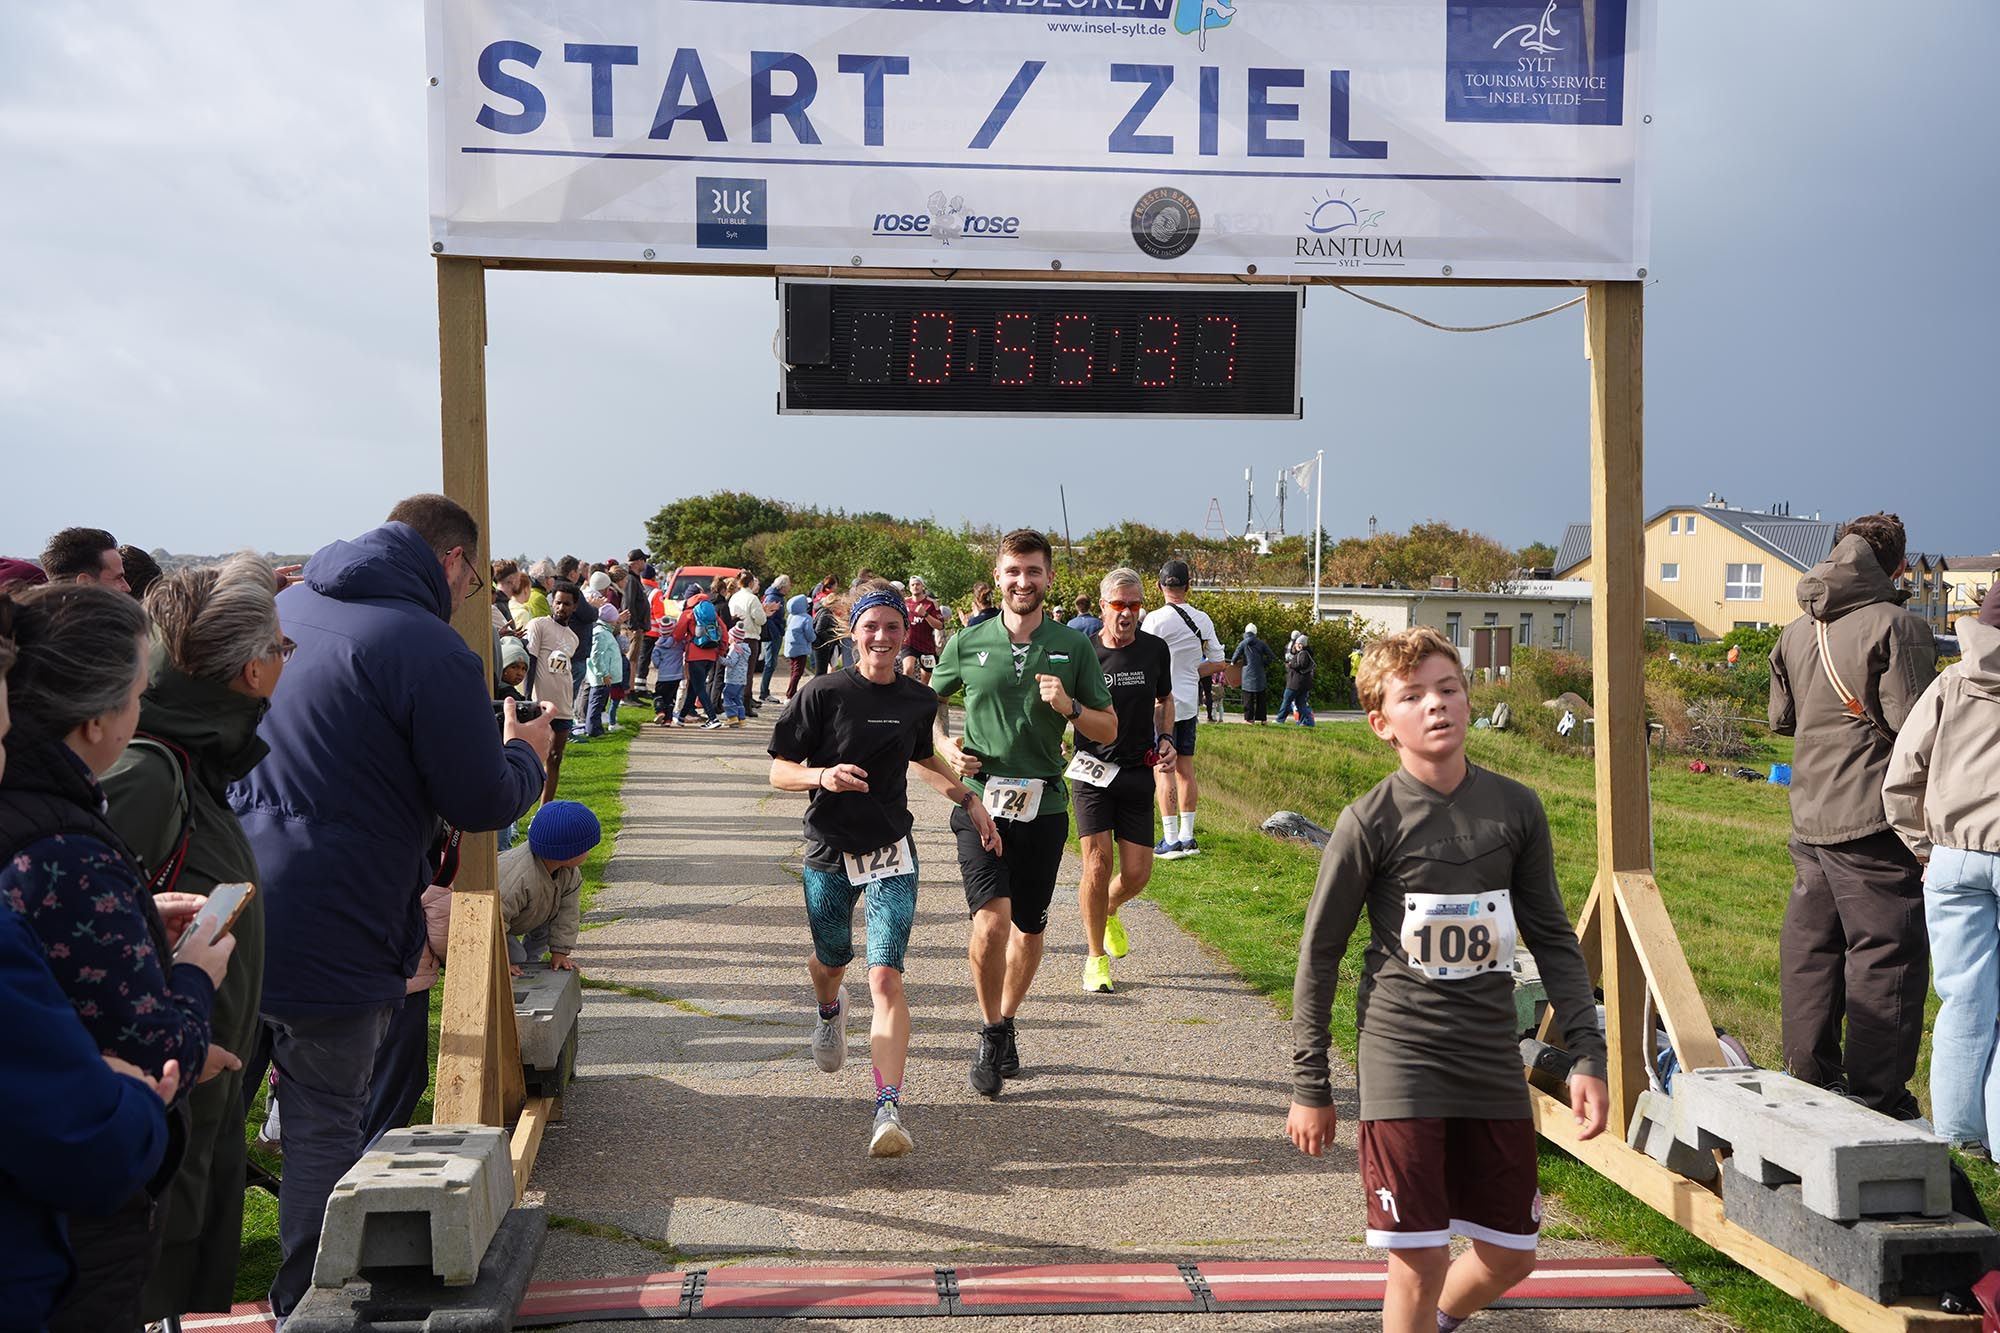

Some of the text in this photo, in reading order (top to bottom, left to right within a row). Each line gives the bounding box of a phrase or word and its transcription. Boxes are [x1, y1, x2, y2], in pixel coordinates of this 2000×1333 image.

[1047, 21, 1167, 38] www.insel-sylt.de
[1517, 57, 1556, 72] SYLT
[1465, 74, 1607, 90] TOURISMUS-SERVICE
[475, 40, 910, 147] START
[1108, 63, 1388, 159] ZIEL
[1489, 92, 1582, 105] INSEL-SYLT.DE
[729, 217, 748, 225] BLUE
[873, 213, 931, 232] rose
[962, 214, 1020, 234] rose
[1295, 236, 1405, 258] RANTUM
[1339, 259, 1361, 268] SYLT
[1071, 758, 1106, 780] 226
[990, 789, 1028, 812] 124
[850, 844, 900, 875] 122
[1413, 924, 1492, 964] 108
